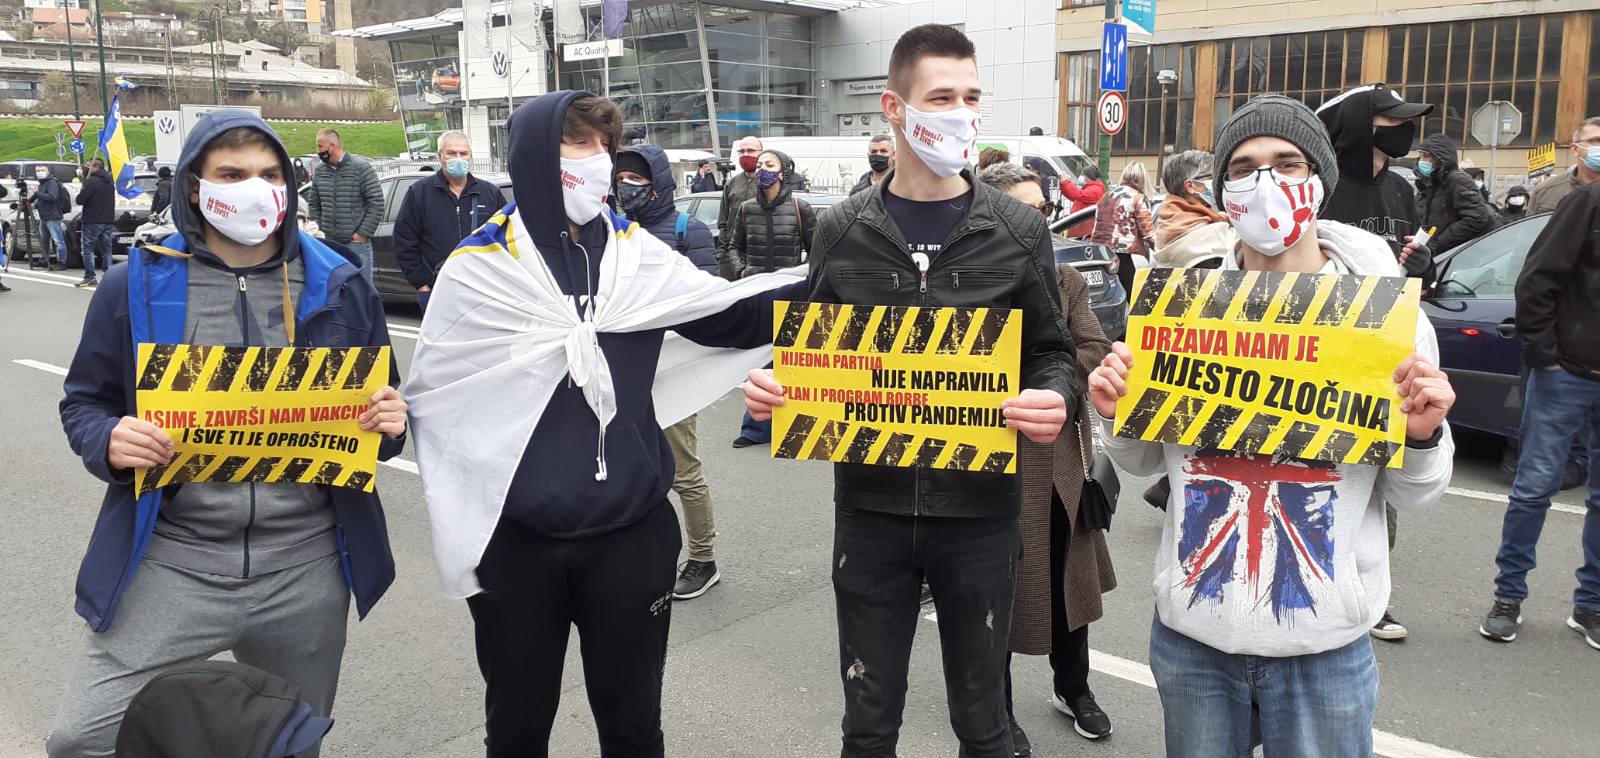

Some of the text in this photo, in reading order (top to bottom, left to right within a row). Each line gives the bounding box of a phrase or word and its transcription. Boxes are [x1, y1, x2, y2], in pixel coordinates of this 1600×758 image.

[574, 47, 583, 57] AC
[1105, 102, 1120, 123] 30
[1141, 323, 1320, 363] DRŽAVA NAM JE
[781, 350, 883, 370] NIJEDNA PARTIJA
[872, 368, 1009, 393] NIJE NAPRAVILA
[1150, 350, 1391, 433] MJESTO ZLOČINA
[781, 385, 810, 401] PLAN
[813, 387, 818, 402] I
[820, 388, 883, 405] PROGRAM
[204, 405, 265, 427] ZAVRŠI
[269, 407, 306, 424] NAM
[310, 404, 368, 421] VAKCIN
[844, 401, 1007, 429] PROTIV PANDEMIJE
[182, 427, 359, 454] I SVE TI JE OPROŠTENO
